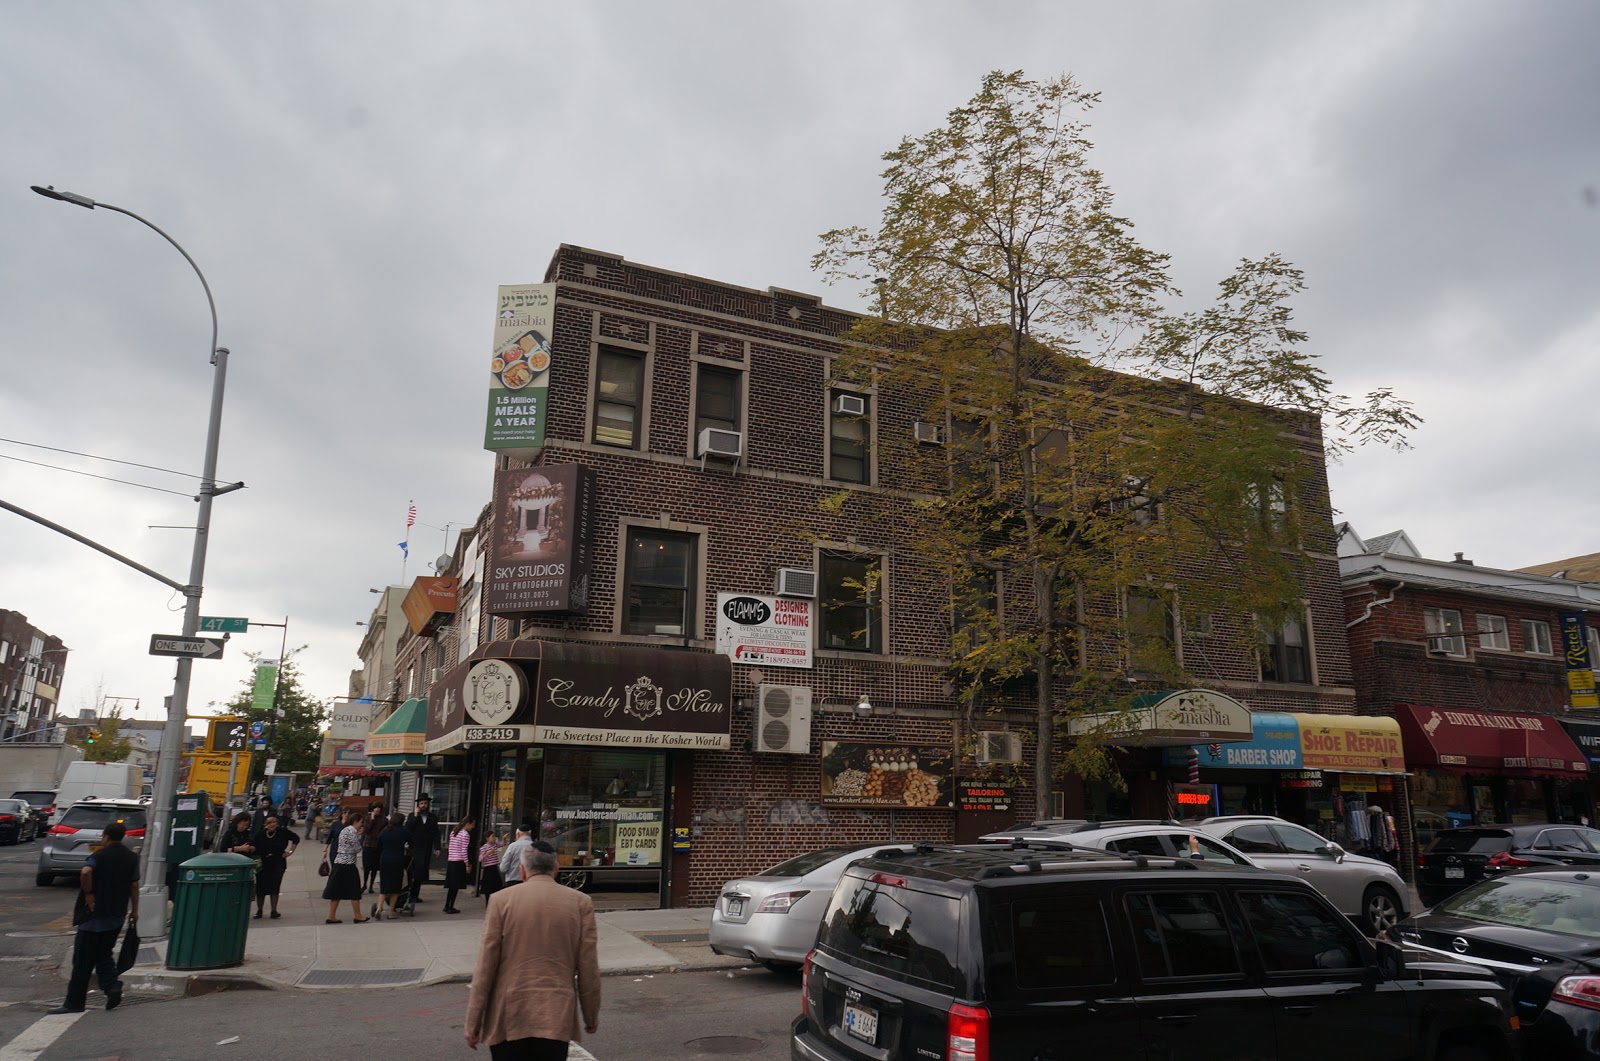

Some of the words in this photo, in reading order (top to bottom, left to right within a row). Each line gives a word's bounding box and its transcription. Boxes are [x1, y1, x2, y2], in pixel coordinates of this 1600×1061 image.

[500, 315, 546, 327] masbia
[497, 396, 509, 404] 1.5
[495, 405, 537, 416] MEALS
[494, 418, 502, 427] A
[506, 417, 536, 426] YEAR
[495, 567, 516, 579] SKY
[518, 563, 565, 578] STUDIOS
[493, 582, 509, 591] FINE
[512, 579, 563, 590] PHOTOGRAPHY
[775, 600, 809, 614] DESIGNER
[205, 618, 225, 631] 47
[774, 613, 809, 627] CLOTHING
[156, 640, 177, 650] ONE
[183, 642, 205, 651] WAY
[546, 678, 620, 718] Candy
[666, 687, 725, 714] Man
[333, 714, 369, 723] GOLD'S
[1179, 709, 1230, 726] masbia
[1444, 711, 1481, 726] EDITH
[1477, 713, 1518, 729] FAMILY
[1516, 717, 1545, 731] SHOP
[467, 728, 514, 740] 438-5419
[542, 729, 560, 740] The
[563, 730, 603, 742] Sweetest
[605, 732, 631, 743] Place
[633, 735, 642, 743] in
[645, 732, 658, 744] the
[661, 734, 692, 745] Kosher
[695, 735, 722, 746] World
[1303, 729, 1342, 751] SHOE
[1344, 730, 1399, 754] REPAIR
[1227, 748, 1268, 765] BARBER
[1270, 749, 1296, 765] SHOP
[1328, 755, 1378, 766] TAILORING
[1504, 757, 1528, 767] EDITH
[1299, 771, 1322, 779] REPAIR
[967, 789, 1005, 797] TAILORING
[1177, 793, 1196, 804] BARBER
[1197, 794, 1210, 805] SHOP
[556, 809, 654, 821] www.koshercandyman.com
[618, 827, 637, 837] FOOD
[637, 826, 660, 837] STAMP
[620, 838, 633, 849] EBT
[635, 838, 657, 849] CARDS
[916, 1047, 941, 1060] LIMITED
